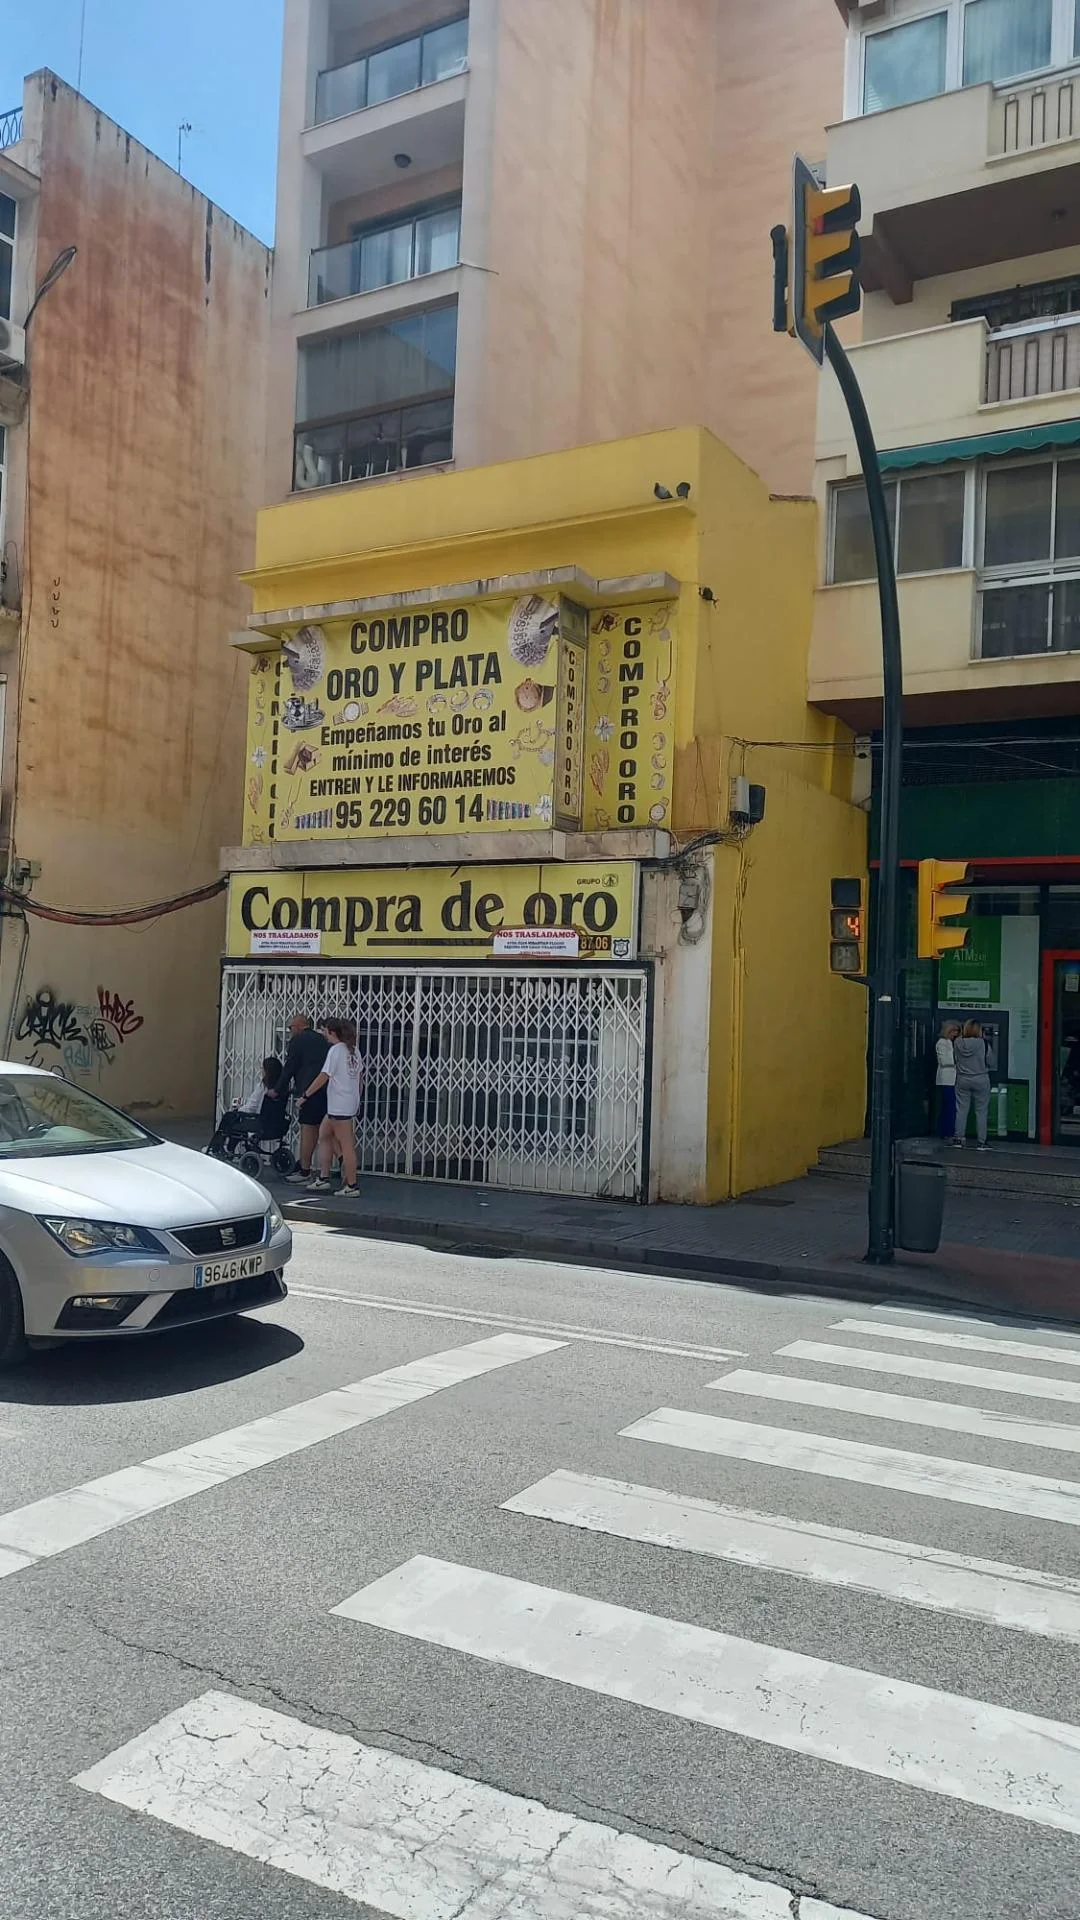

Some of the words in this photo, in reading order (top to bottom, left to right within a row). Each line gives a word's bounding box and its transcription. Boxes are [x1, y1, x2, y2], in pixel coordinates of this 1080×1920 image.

[351, 608, 469, 654] COMPRO
[327, 665, 379, 701] ORO
[389, 662, 406, 694] Y
[416, 652, 502, 691] PLATA
[619, 617, 644, 750] COMPRO
[566, 650, 576, 751] COMPRO
[321, 722, 422, 748] Empeñamos
[428, 718, 446, 737] tu
[452, 714, 483, 735] Oro
[489, 710, 506, 732] al
[333, 751, 395, 771] mínimo
[400, 747, 421, 767] de
[428, 740, 491, 764] interés
[310, 777, 361, 797] ENTREN
[366, 776, 374, 793] Y
[378, 775, 393, 792] LE
[398, 767, 516, 791] INFORMAREMOS
[564, 757, 572, 806] ORO
[618, 759, 637, 823] ORO
[336, 801, 362, 829] 95
[370, 797, 411, 827] 229
[419, 796, 447, 825] 60
[455, 794, 484, 823] 14
[242, 887, 423, 946] Compra
[441, 880, 505, 932] de
[523, 892, 617, 932] oro
[497, 930, 513, 938] NOS
[515, 929, 576, 938] TRASLADAMOS
[204, 1262, 237, 1284] 9646
[240, 1256, 263, 1277] KWP
